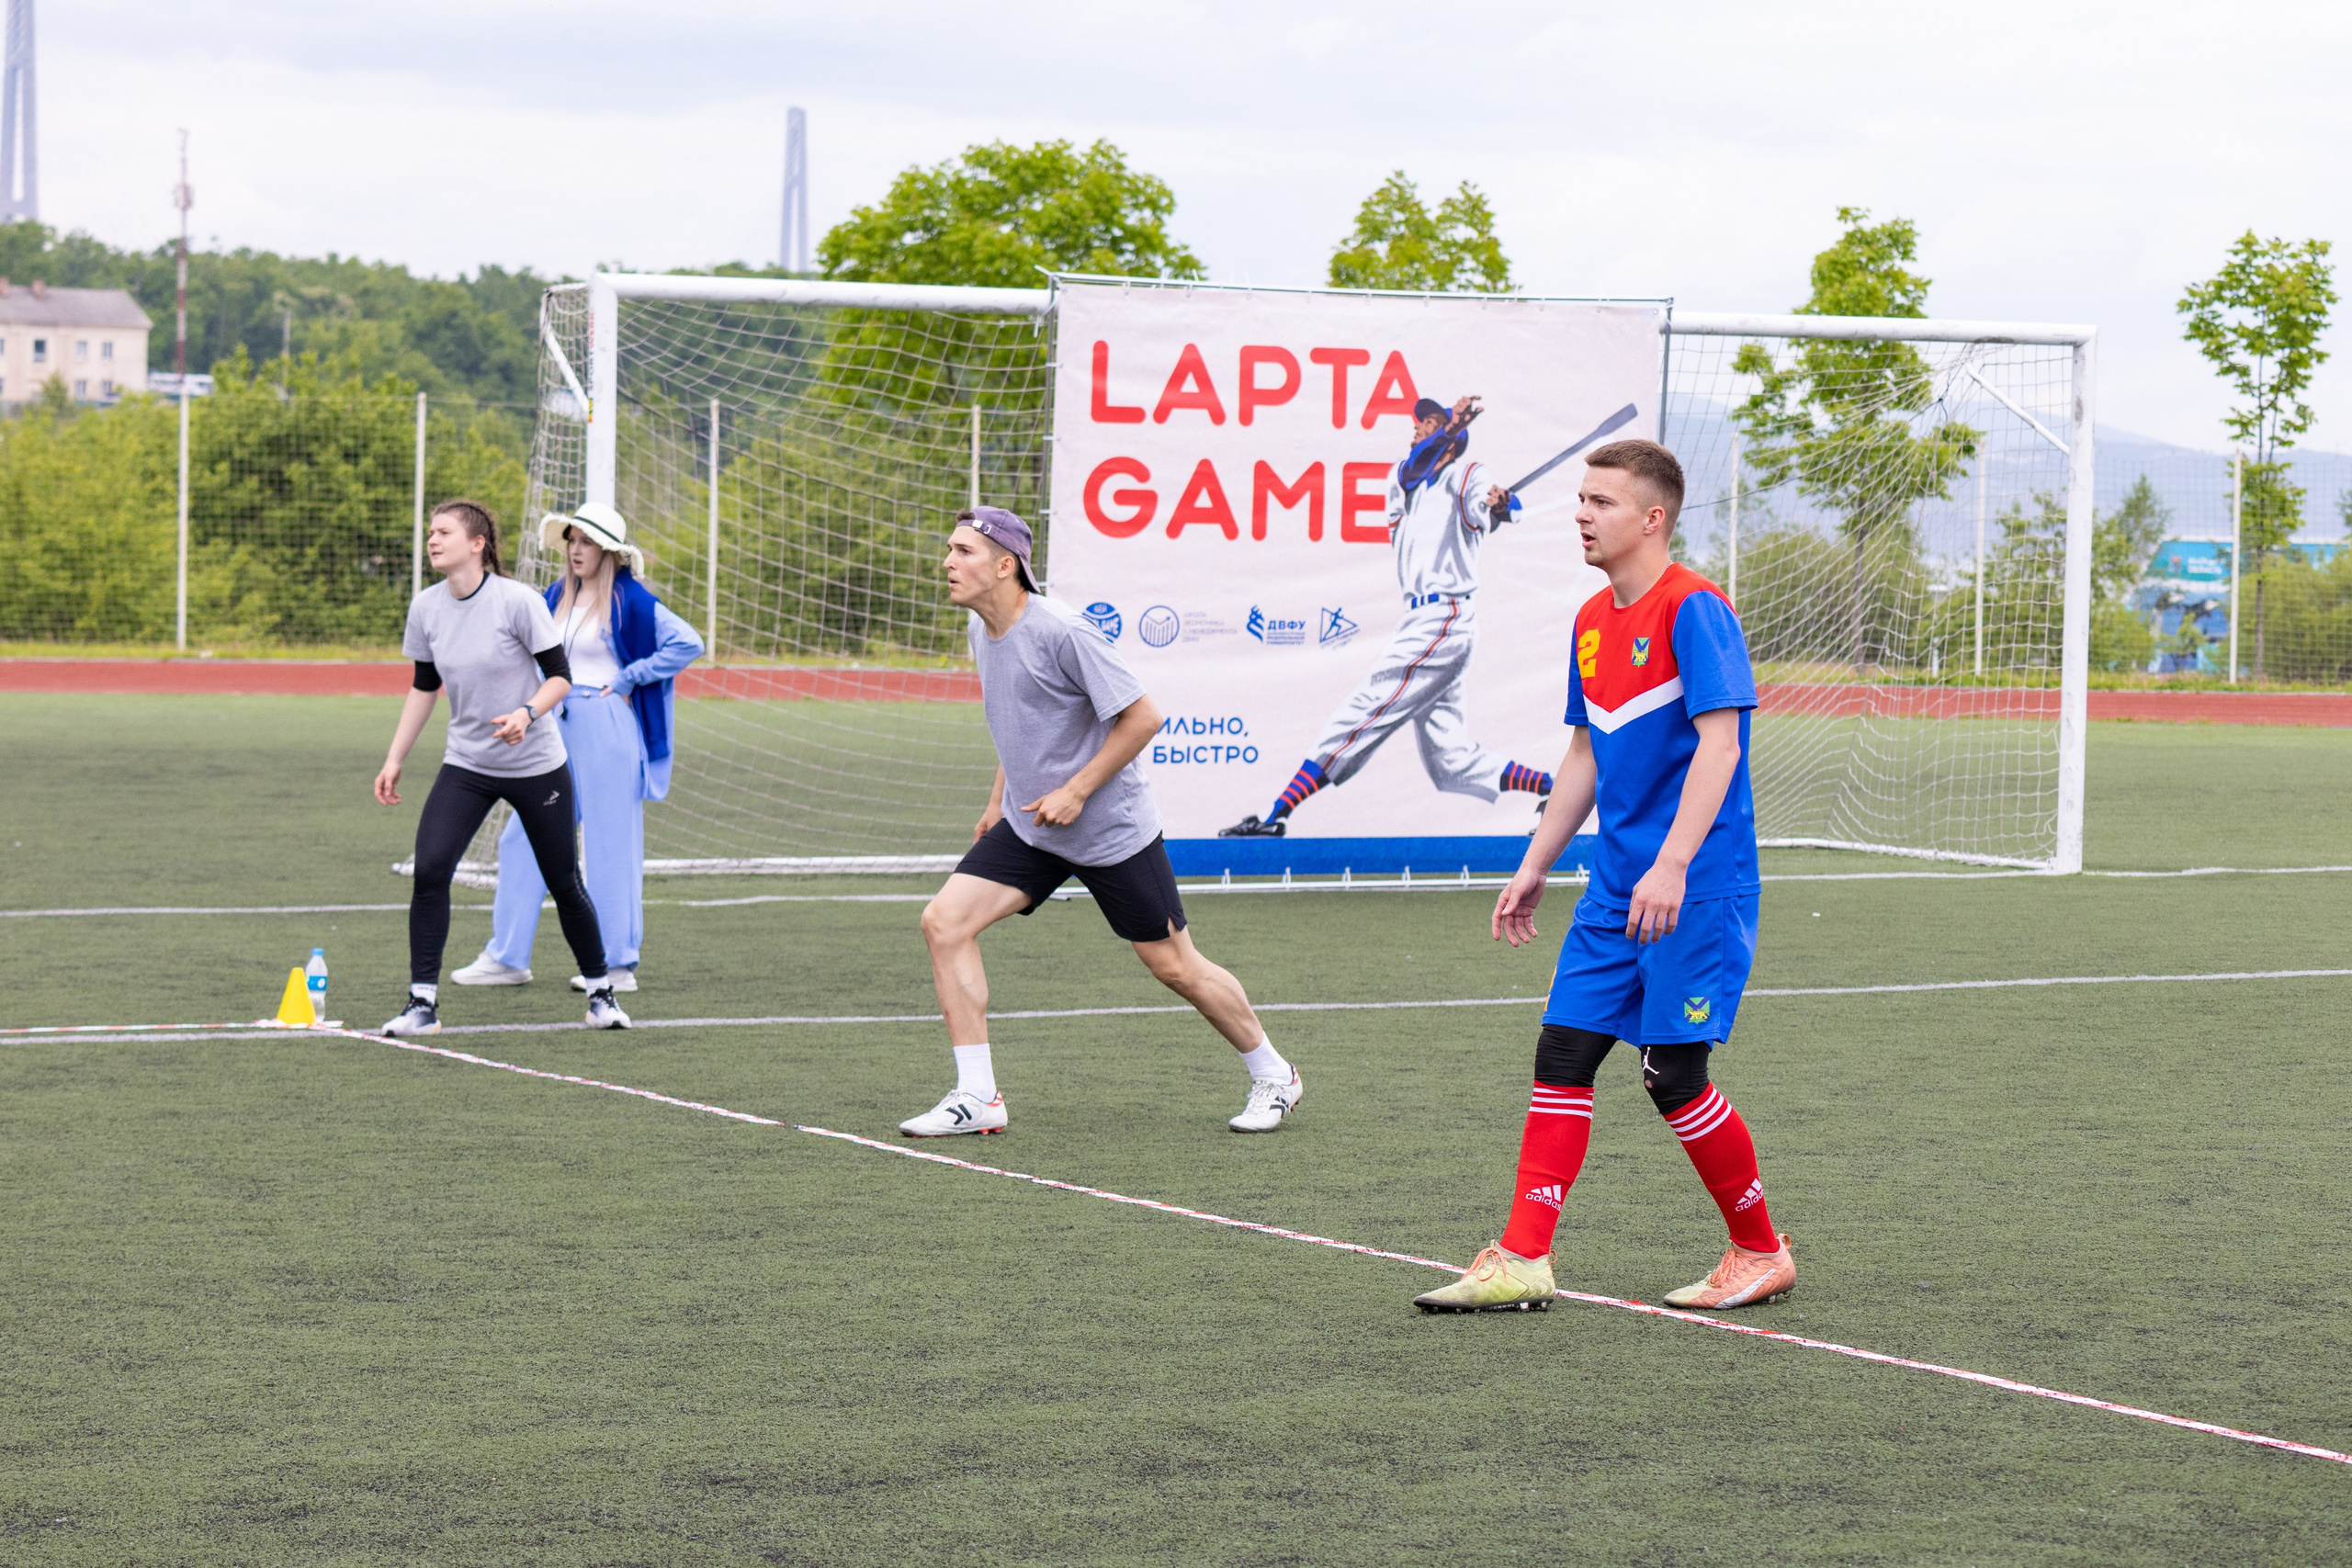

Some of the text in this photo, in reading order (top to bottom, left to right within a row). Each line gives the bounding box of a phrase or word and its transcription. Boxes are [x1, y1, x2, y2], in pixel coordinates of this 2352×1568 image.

[1091, 340, 1421, 429] LAPTA
[1083, 457, 1393, 543] GAME
[1268, 620, 1306, 631] ДВФУ
[1577, 628, 1601, 679] 2
[1157, 716, 1249, 738] ИЛЬНО,
[1153, 746, 1259, 763] БЫСТРО
[1525, 1193, 1562, 1212] adidas
[1735, 1187, 1764, 1212] adida
